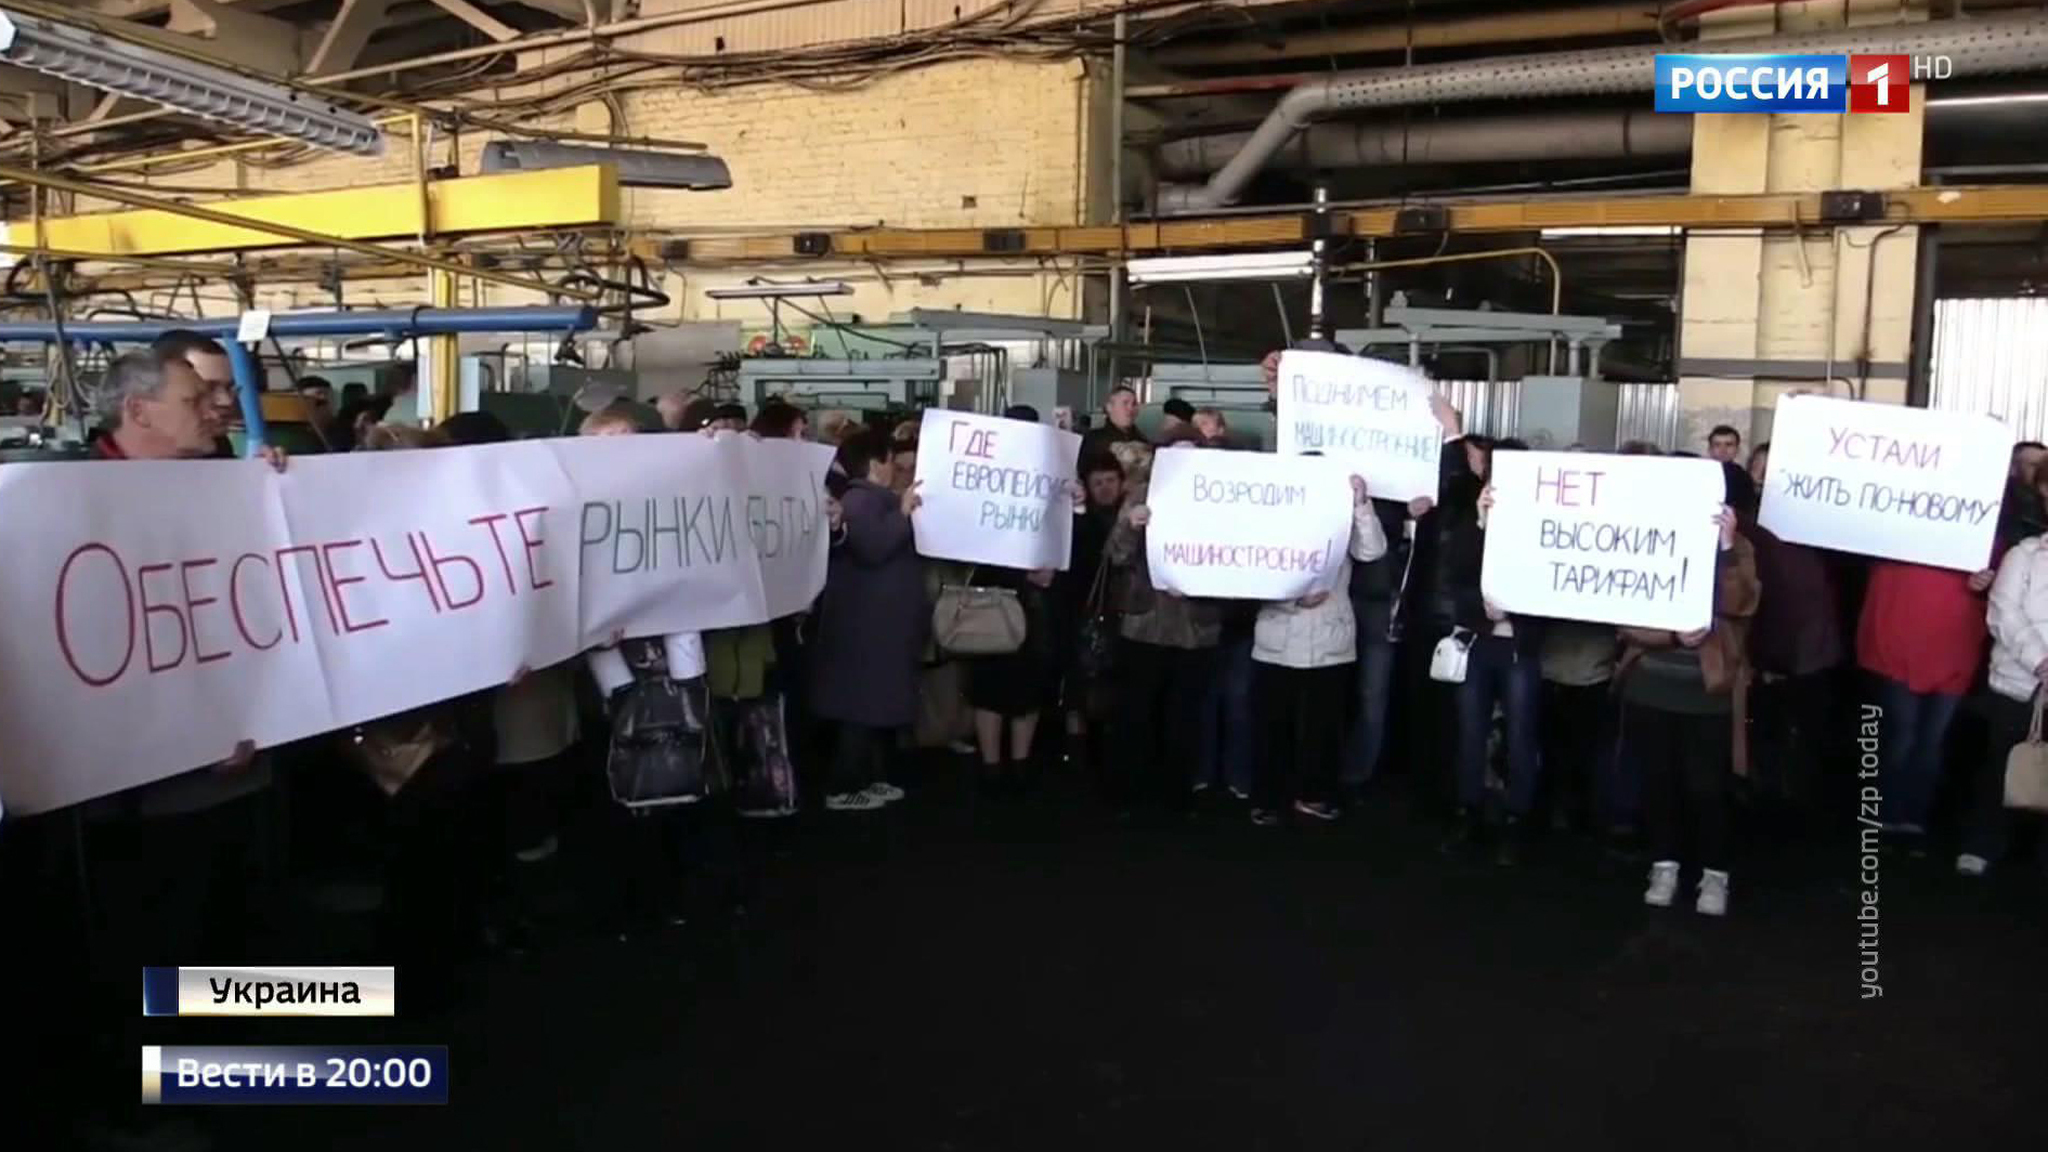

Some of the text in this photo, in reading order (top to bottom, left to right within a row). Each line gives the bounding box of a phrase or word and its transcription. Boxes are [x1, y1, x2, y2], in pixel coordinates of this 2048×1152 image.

[949, 420, 999, 459] ГДЕ
[1828, 426, 1942, 469] УСТАЛИ
[952, 460, 1072, 501] ЕВРОПЕЙСК
[1192, 473, 1307, 507] ВОЗРОДИМ
[1535, 465, 1607, 507] НЕТ
[1163, 537, 1333, 574] МАШИНОСТРОЕНИЕ!
[1539, 518, 1677, 558] ВЫСОКИМ
[55, 506, 555, 688] ОБЕСПЕЧЬТЕ
[578, 495, 739, 577] РЫНКИ
[1548, 556, 1689, 602] ТАРИФАМ!
